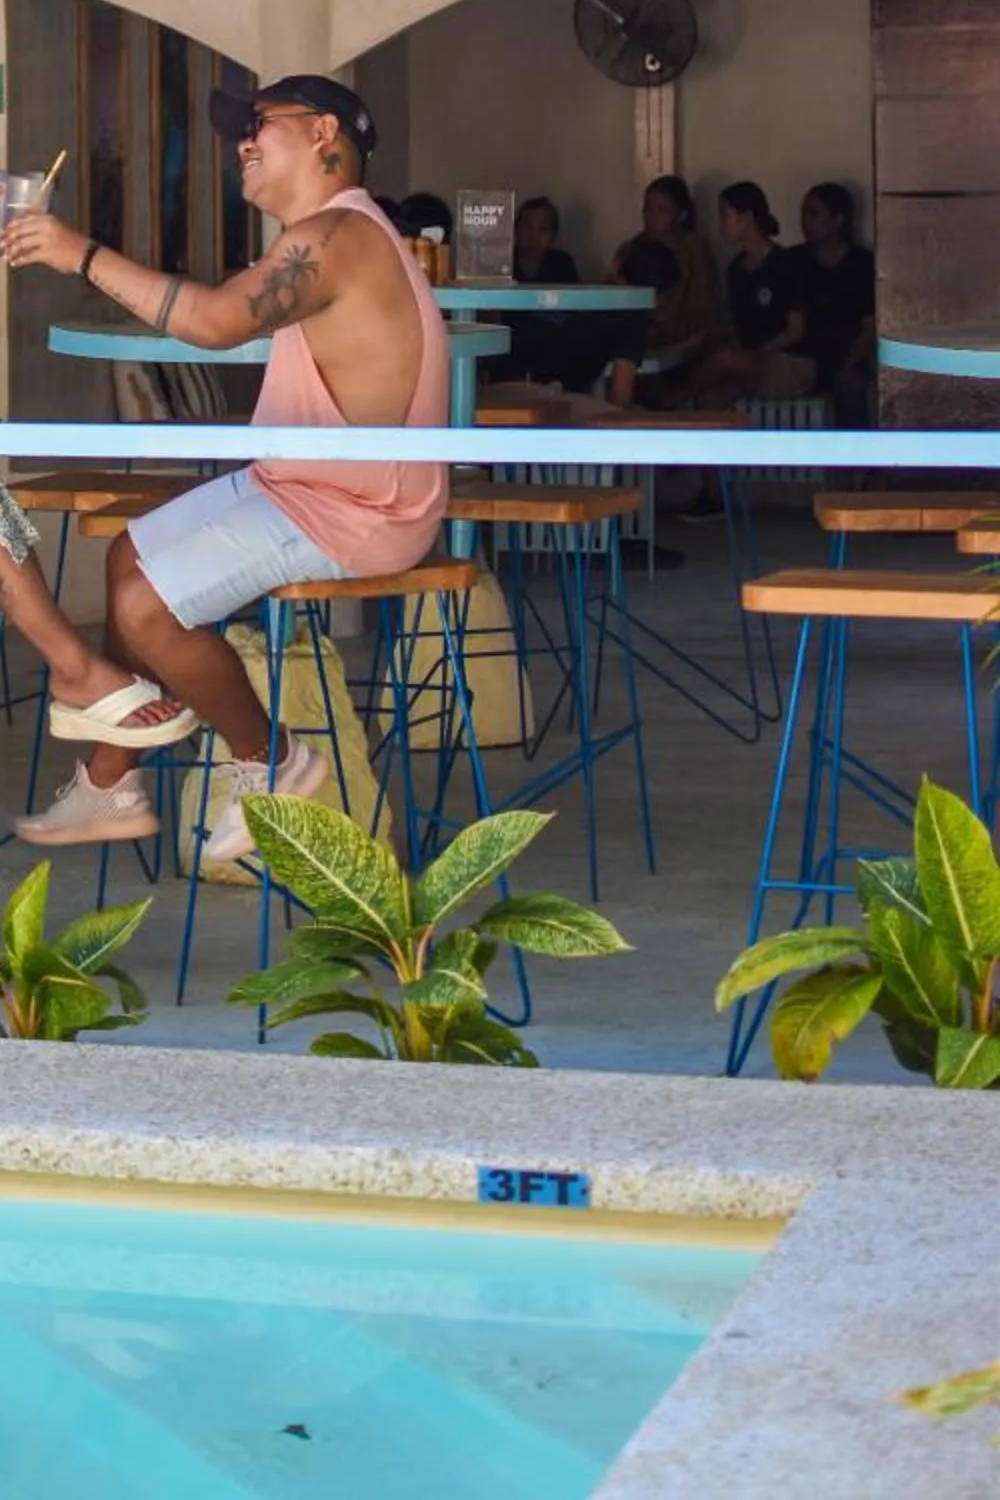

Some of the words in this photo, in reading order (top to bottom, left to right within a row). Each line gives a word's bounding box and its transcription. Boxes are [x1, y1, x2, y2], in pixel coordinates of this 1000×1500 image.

[464, 205, 504, 216] HAPPY
[464, 215, 498, 226] HOUR
[487, 1168, 580, 1206] 3FT
